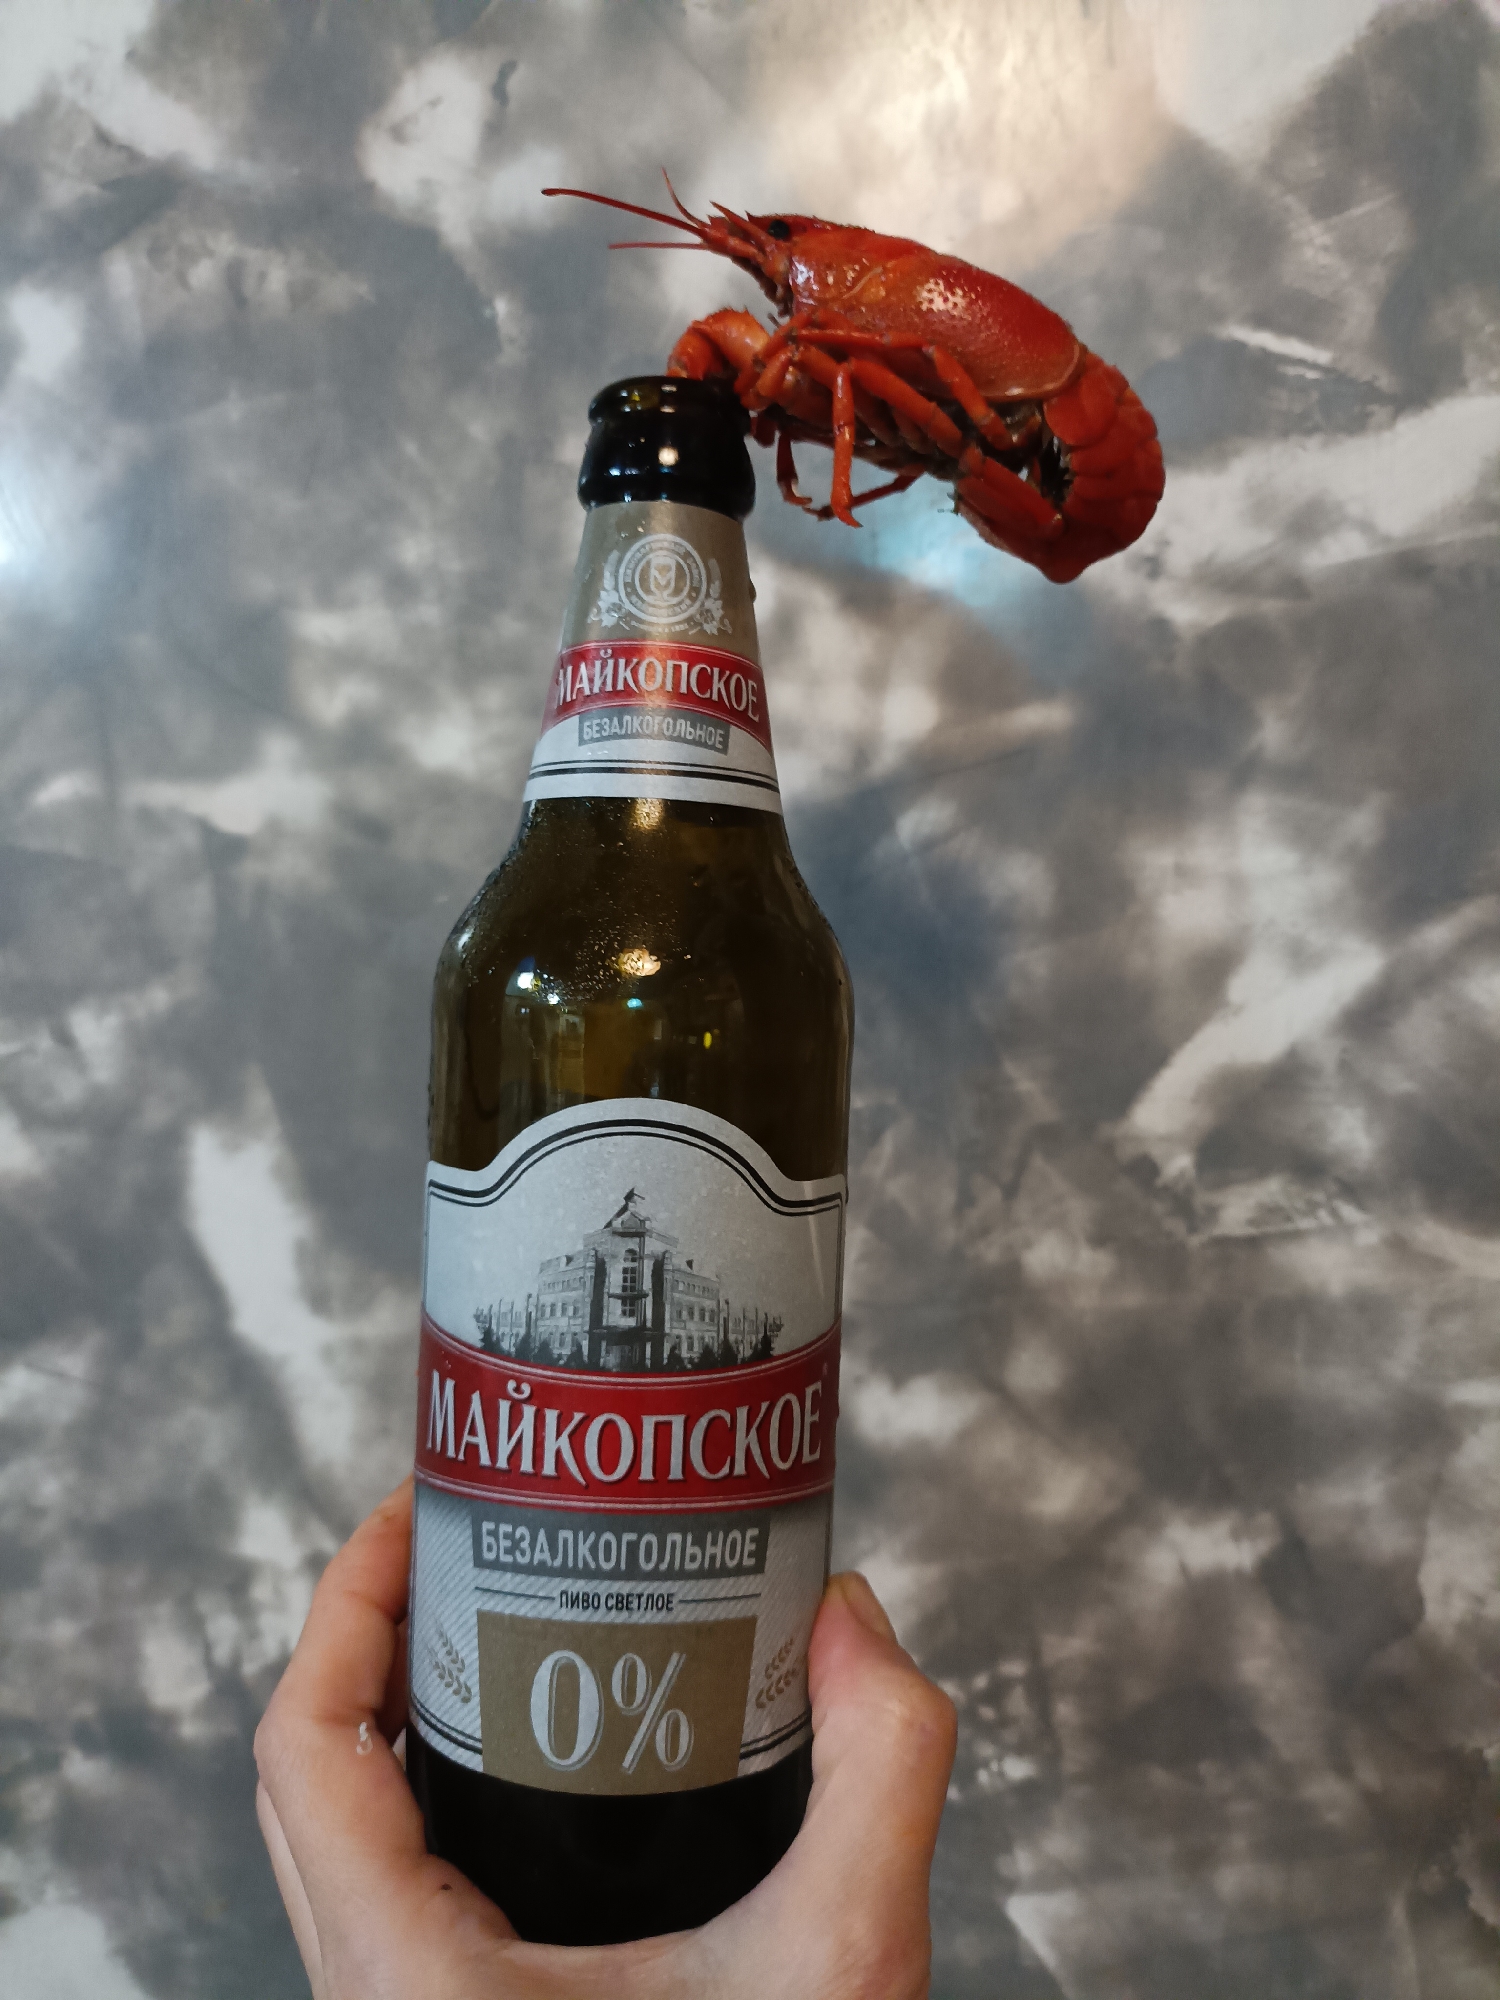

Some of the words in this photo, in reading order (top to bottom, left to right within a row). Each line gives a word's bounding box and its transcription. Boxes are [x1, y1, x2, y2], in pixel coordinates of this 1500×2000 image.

[555, 649, 760, 723] МАЙКОПСКОЕ
[582, 713, 725, 749] БЕЗАЛКОГОЛЬНОЕ
[427, 1369, 822, 1488] МАЙКОПСКОЕ
[481, 1520, 760, 1572] БЕЗАЛКОГОЛЬНОЕ
[558, 1589, 601, 1611] ПИВО
[604, 1591, 675, 1612] СВЕТЛОЕ
[530, 1649, 694, 1775] 0%
